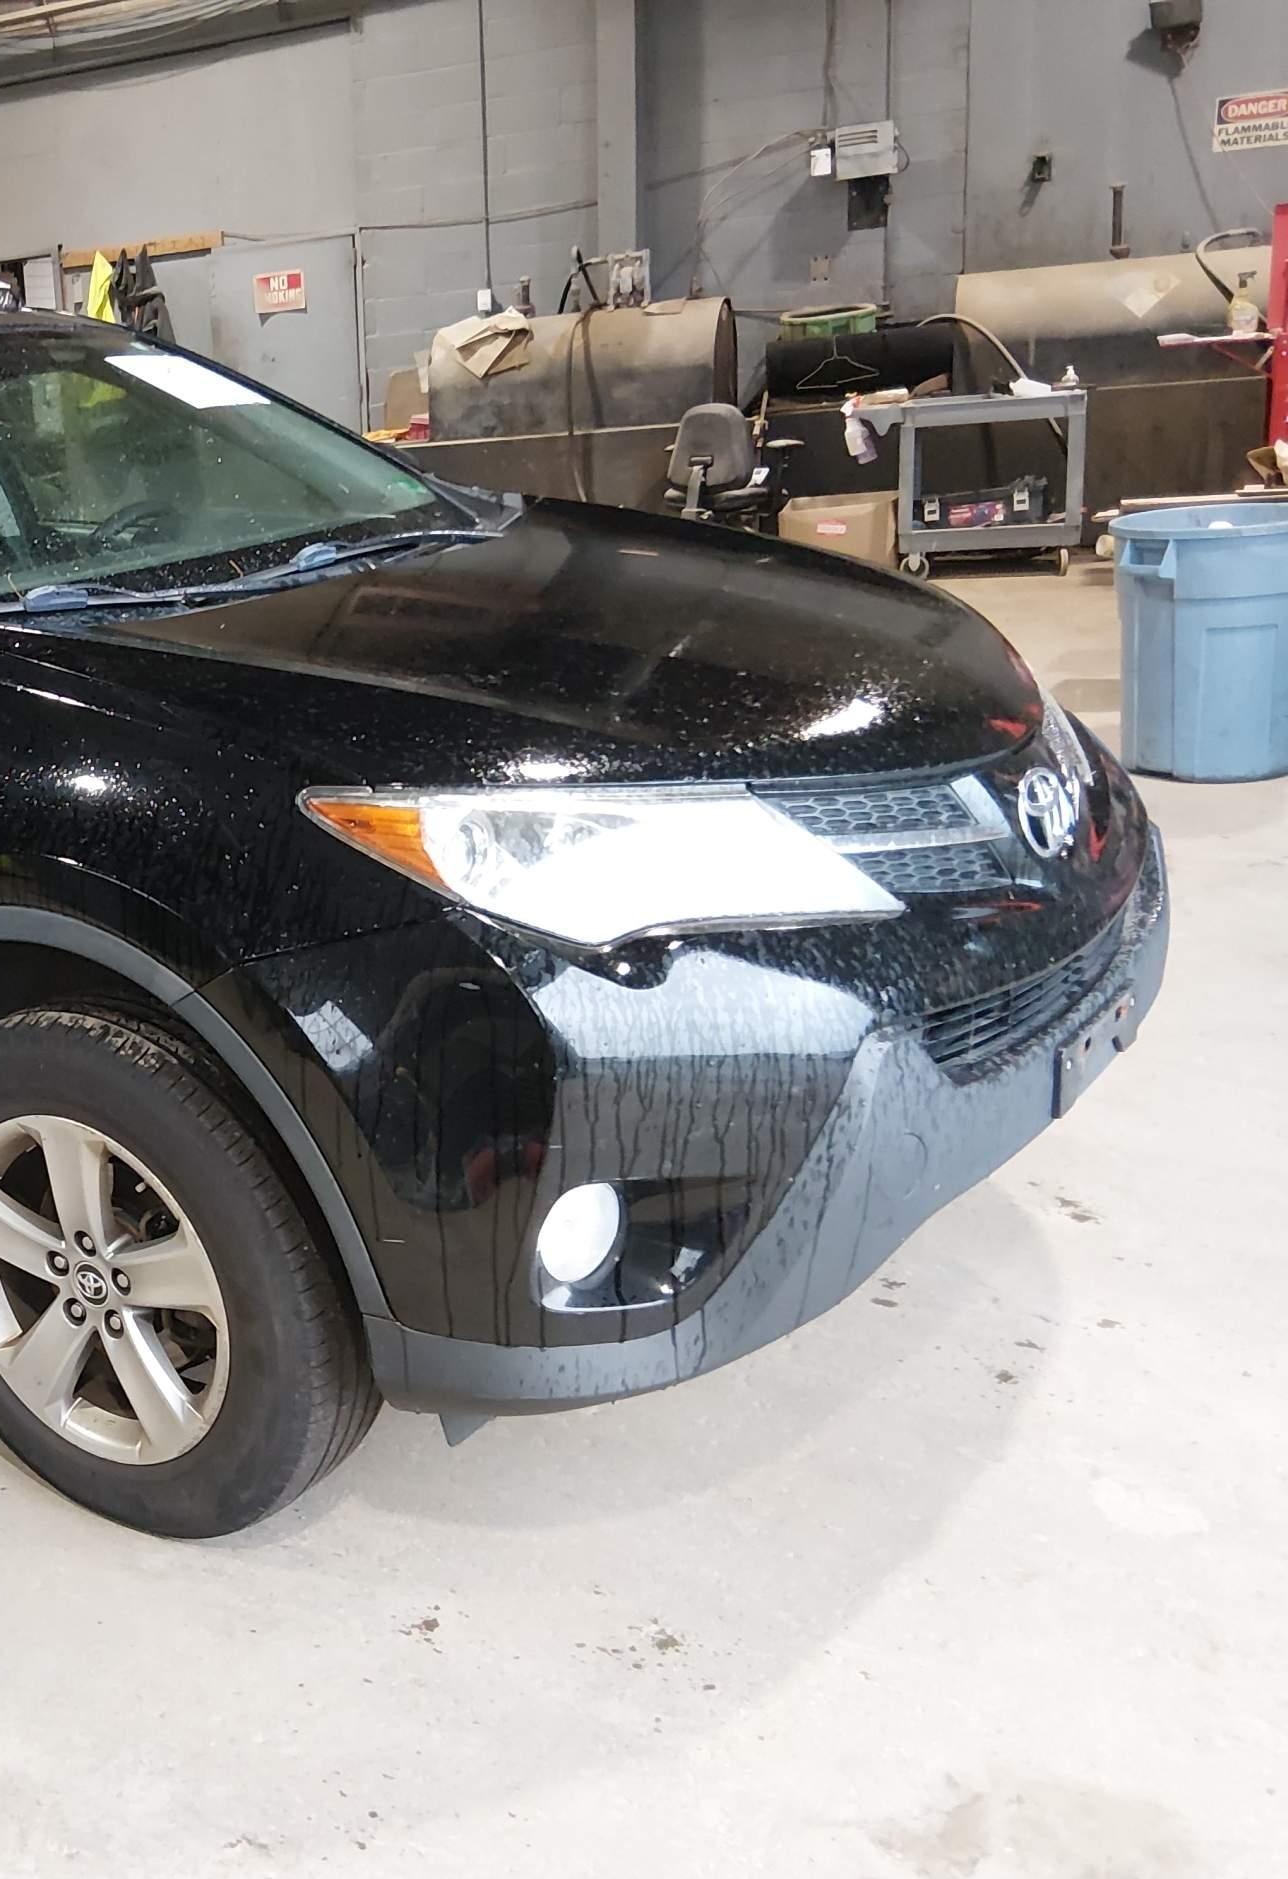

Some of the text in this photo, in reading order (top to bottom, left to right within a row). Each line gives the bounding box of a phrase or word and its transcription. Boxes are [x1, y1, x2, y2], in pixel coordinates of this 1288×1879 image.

[1227, 98, 1288, 118] DANGER
[1218, 120, 1288, 136] FLAMMABL
[269, 275, 288, 291] NO
